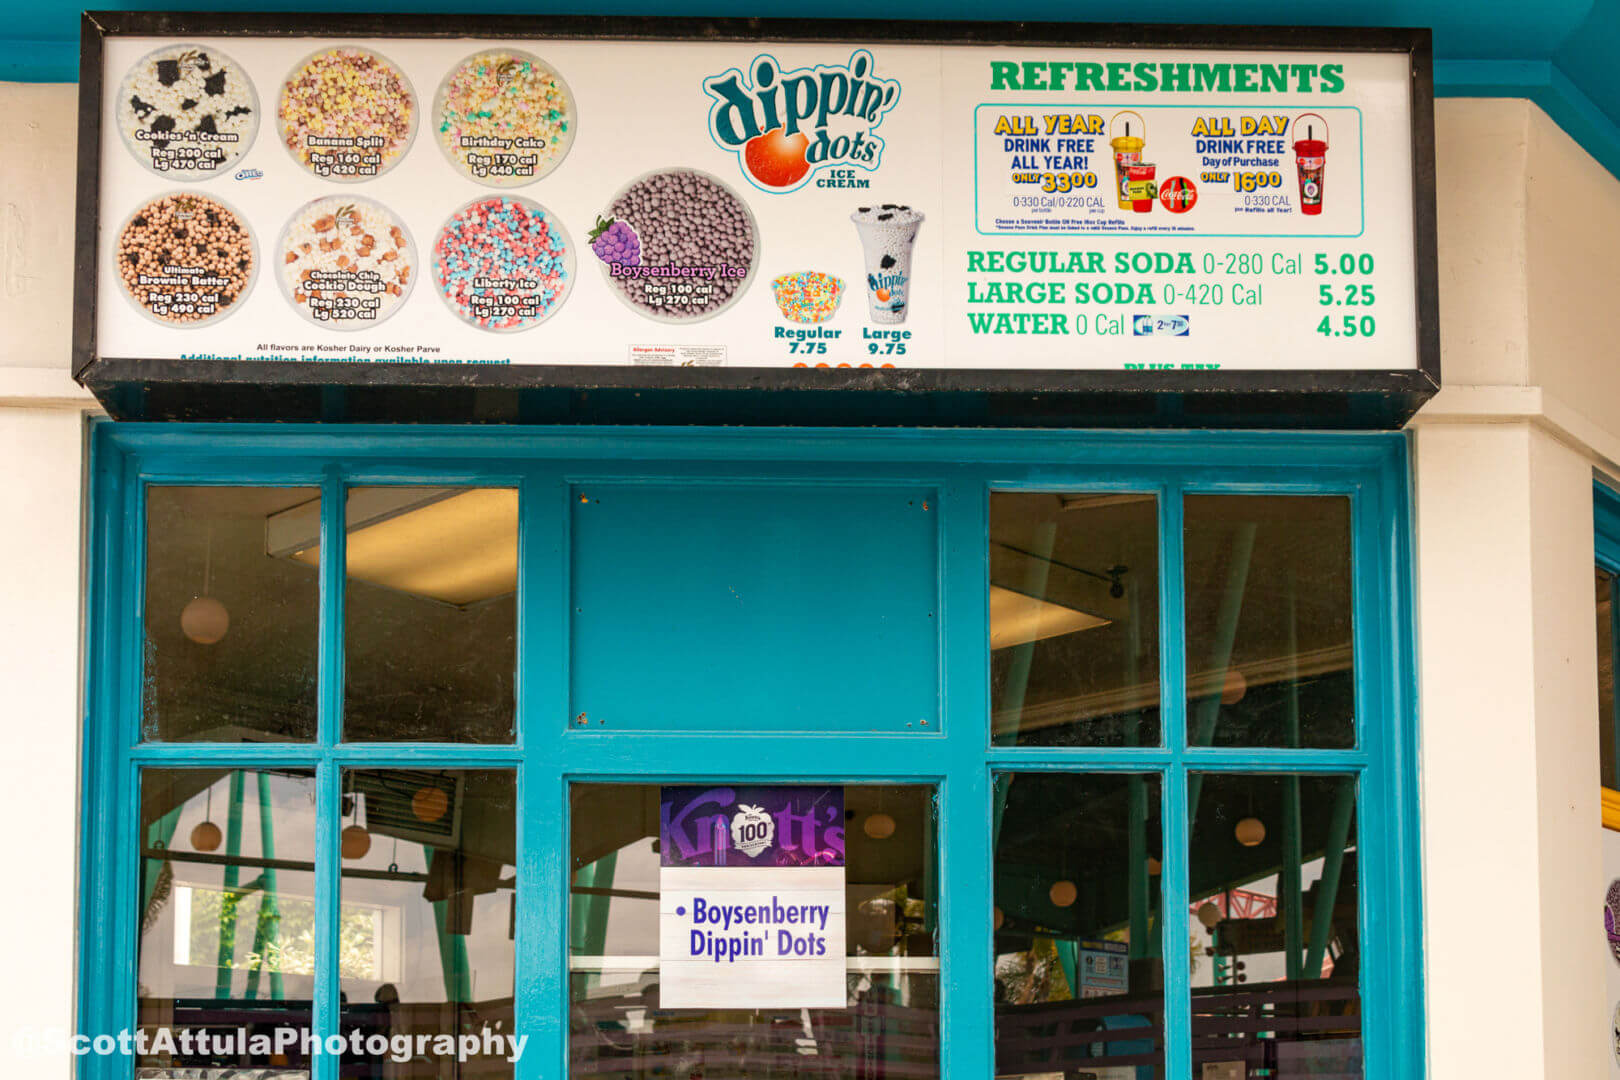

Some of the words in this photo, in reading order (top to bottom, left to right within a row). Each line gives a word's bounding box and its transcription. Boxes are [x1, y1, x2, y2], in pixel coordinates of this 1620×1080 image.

[990, 61, 1345, 93] REFRESHMENTS
[994, 115, 1038, 136] ALL
[1043, 114, 1105, 135] YEAR
[1191, 117, 1236, 137] ALL
[1241, 115, 1289, 136] DAY
[135, 129, 183, 141] Cookies
[199, 131, 239, 142] Cream
[308, 135, 354, 147] Banana
[355, 136, 385, 149] Split
[460, 136, 513, 150] Birthday
[514, 137, 546, 148] Cake
[806, 129, 877, 164] dots
[1004, 138, 1050, 153] DRINK
[1057, 138, 1095, 153] FREE
[1196, 140, 1244, 154] DRINK
[1247, 140, 1285, 154] FREE
[151, 147, 176, 159] Reg
[178, 148, 202, 159] 200
[203, 148, 222, 159] cal
[310, 153, 335, 165] Reg
[337, 153, 361, 164] 160
[362, 153, 381, 164] cal
[468, 153, 492, 165] Reg
[494, 154, 518, 165] 170
[519, 154, 538, 165] cal
[153, 159, 169, 171] Lg
[171, 159, 195, 170] 470
[197, 160, 216, 170] cal
[1011, 155, 1039, 170] ALL
[1044, 156, 1088, 170] YEAR!
[1203, 157, 1222, 168] Day
[1222, 157, 1232, 166] of
[1233, 157, 1279, 167] Purchase
[315, 164, 331, 176] Lg
[332, 165, 357, 175] 420
[358, 164, 377, 175] cal
[472, 165, 487, 177] Lg
[489, 165, 513, 176] 440
[515, 166, 534, 176] cal
[830, 169, 856, 179] ICE
[1012, 173, 1041, 184] ONLY
[1200, 172, 1230, 183] ONLY
[816, 179, 870, 189] CREAM
[1086, 197, 1105, 208] CAL
[1272, 196, 1291, 206] CAL
[967, 251, 1106, 273] REGULAR
[1115, 252, 1196, 274] SODA
[1203, 253, 1263, 275] 0-280
[1271, 252, 1302, 275] Cal
[1314, 253, 1375, 275] 5.00
[163, 265, 205, 274] Ultimate
[610, 262, 716, 280] Boysenberry
[720, 263, 746, 278] Ice
[138, 275, 188, 286] Brownie
[190, 276, 230, 287] Batter
[310, 271, 357, 280] Chocolate
[358, 271, 380, 282] Chip
[304, 280, 345, 291] Cookie
[347, 281, 387, 294] Dough
[473, 277, 516, 290] Liberty
[519, 278, 537, 289] Ice
[644, 284, 667, 296] Reg
[671, 284, 693, 294] 100
[695, 284, 713, 294] cal
[967, 282, 1065, 304] LARGE
[1075, 283, 1156, 304] SODA
[1164, 283, 1223, 305] 0-420
[1232, 283, 1262, 305] Cal
[1319, 284, 1376, 306] 5.25
[149, 293, 172, 304] Reg
[174, 293, 199, 303] 230
[201, 292, 219, 303] cal
[309, 297, 334, 309] Reg
[335, 298, 360, 308] 230
[361, 297, 381, 308] cal
[470, 295, 495, 307] Reg
[497, 295, 520, 306] 100
[522, 295, 541, 306] cal
[648, 295, 663, 306] Lg
[666, 295, 688, 304] 270
[692, 295, 708, 304] cal
[153, 303, 168, 315] Lg
[170, 303, 195, 314] 490
[197, 304, 215, 314] cal
[313, 308, 329, 320] Lg
[331, 308, 356, 319] 520
[357, 308, 376, 319] cal
[474, 306, 490, 318] Lg
[492, 306, 516, 317] 270
[517, 306, 536, 317] cal
[967, 313, 1069, 334] WATER
[1076, 314, 1088, 335] 0
[1095, 313, 1124, 335] Cal
[1317, 315, 1376, 337] 4.50
[1157, 320, 1164, 330] 2
[774, 326, 842, 341] Regular
[863, 327, 912, 342] Large
[257, 343, 268, 351] All
[270, 343, 299, 351] flavors
[349, 345, 371, 354] Dairy
[789, 342, 827, 354] 7.75
[868, 343, 906, 355] 9.75
[661, 787, 845, 860] Kntt's
[693, 896, 829, 931] Boysenberry
[691, 929, 769, 963] Dippin'
[777, 929, 826, 956] Dots
